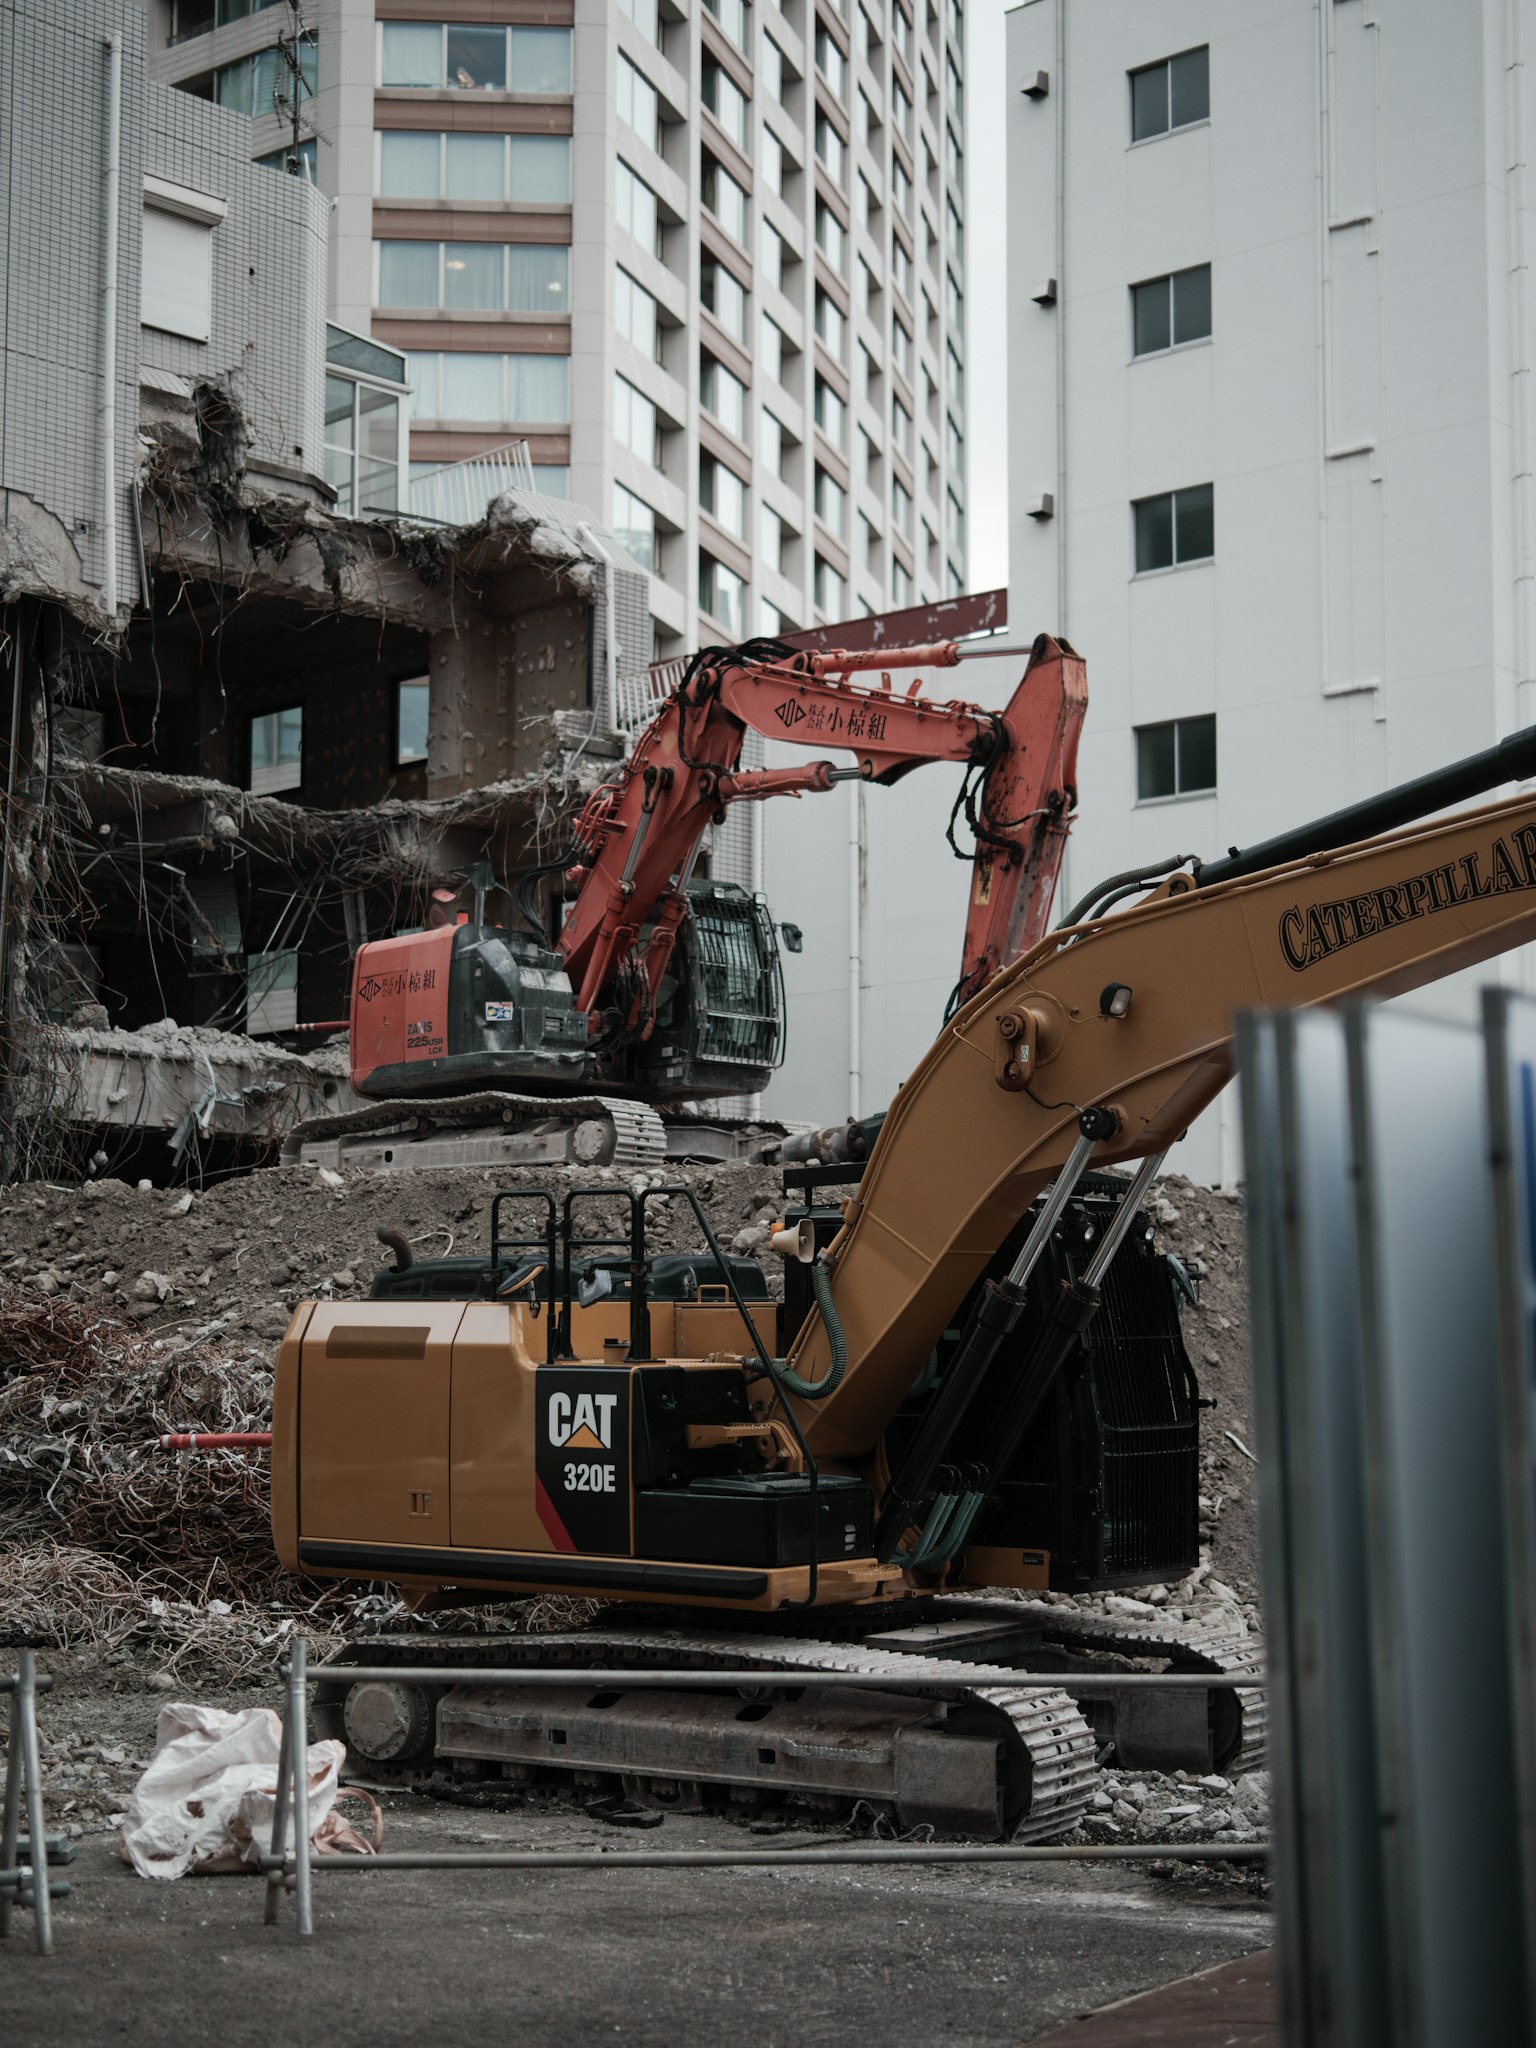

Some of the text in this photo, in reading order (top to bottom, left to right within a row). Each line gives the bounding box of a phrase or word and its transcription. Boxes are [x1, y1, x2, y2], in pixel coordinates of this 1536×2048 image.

[827, 707, 887, 740] 小椋組
[1279, 822, 1536, 972] CATERPILLAR
[395, 969, 436, 995] 小椋組
[548, 1391, 618, 1449] CAT
[563, 1462, 616, 1493] 320E
